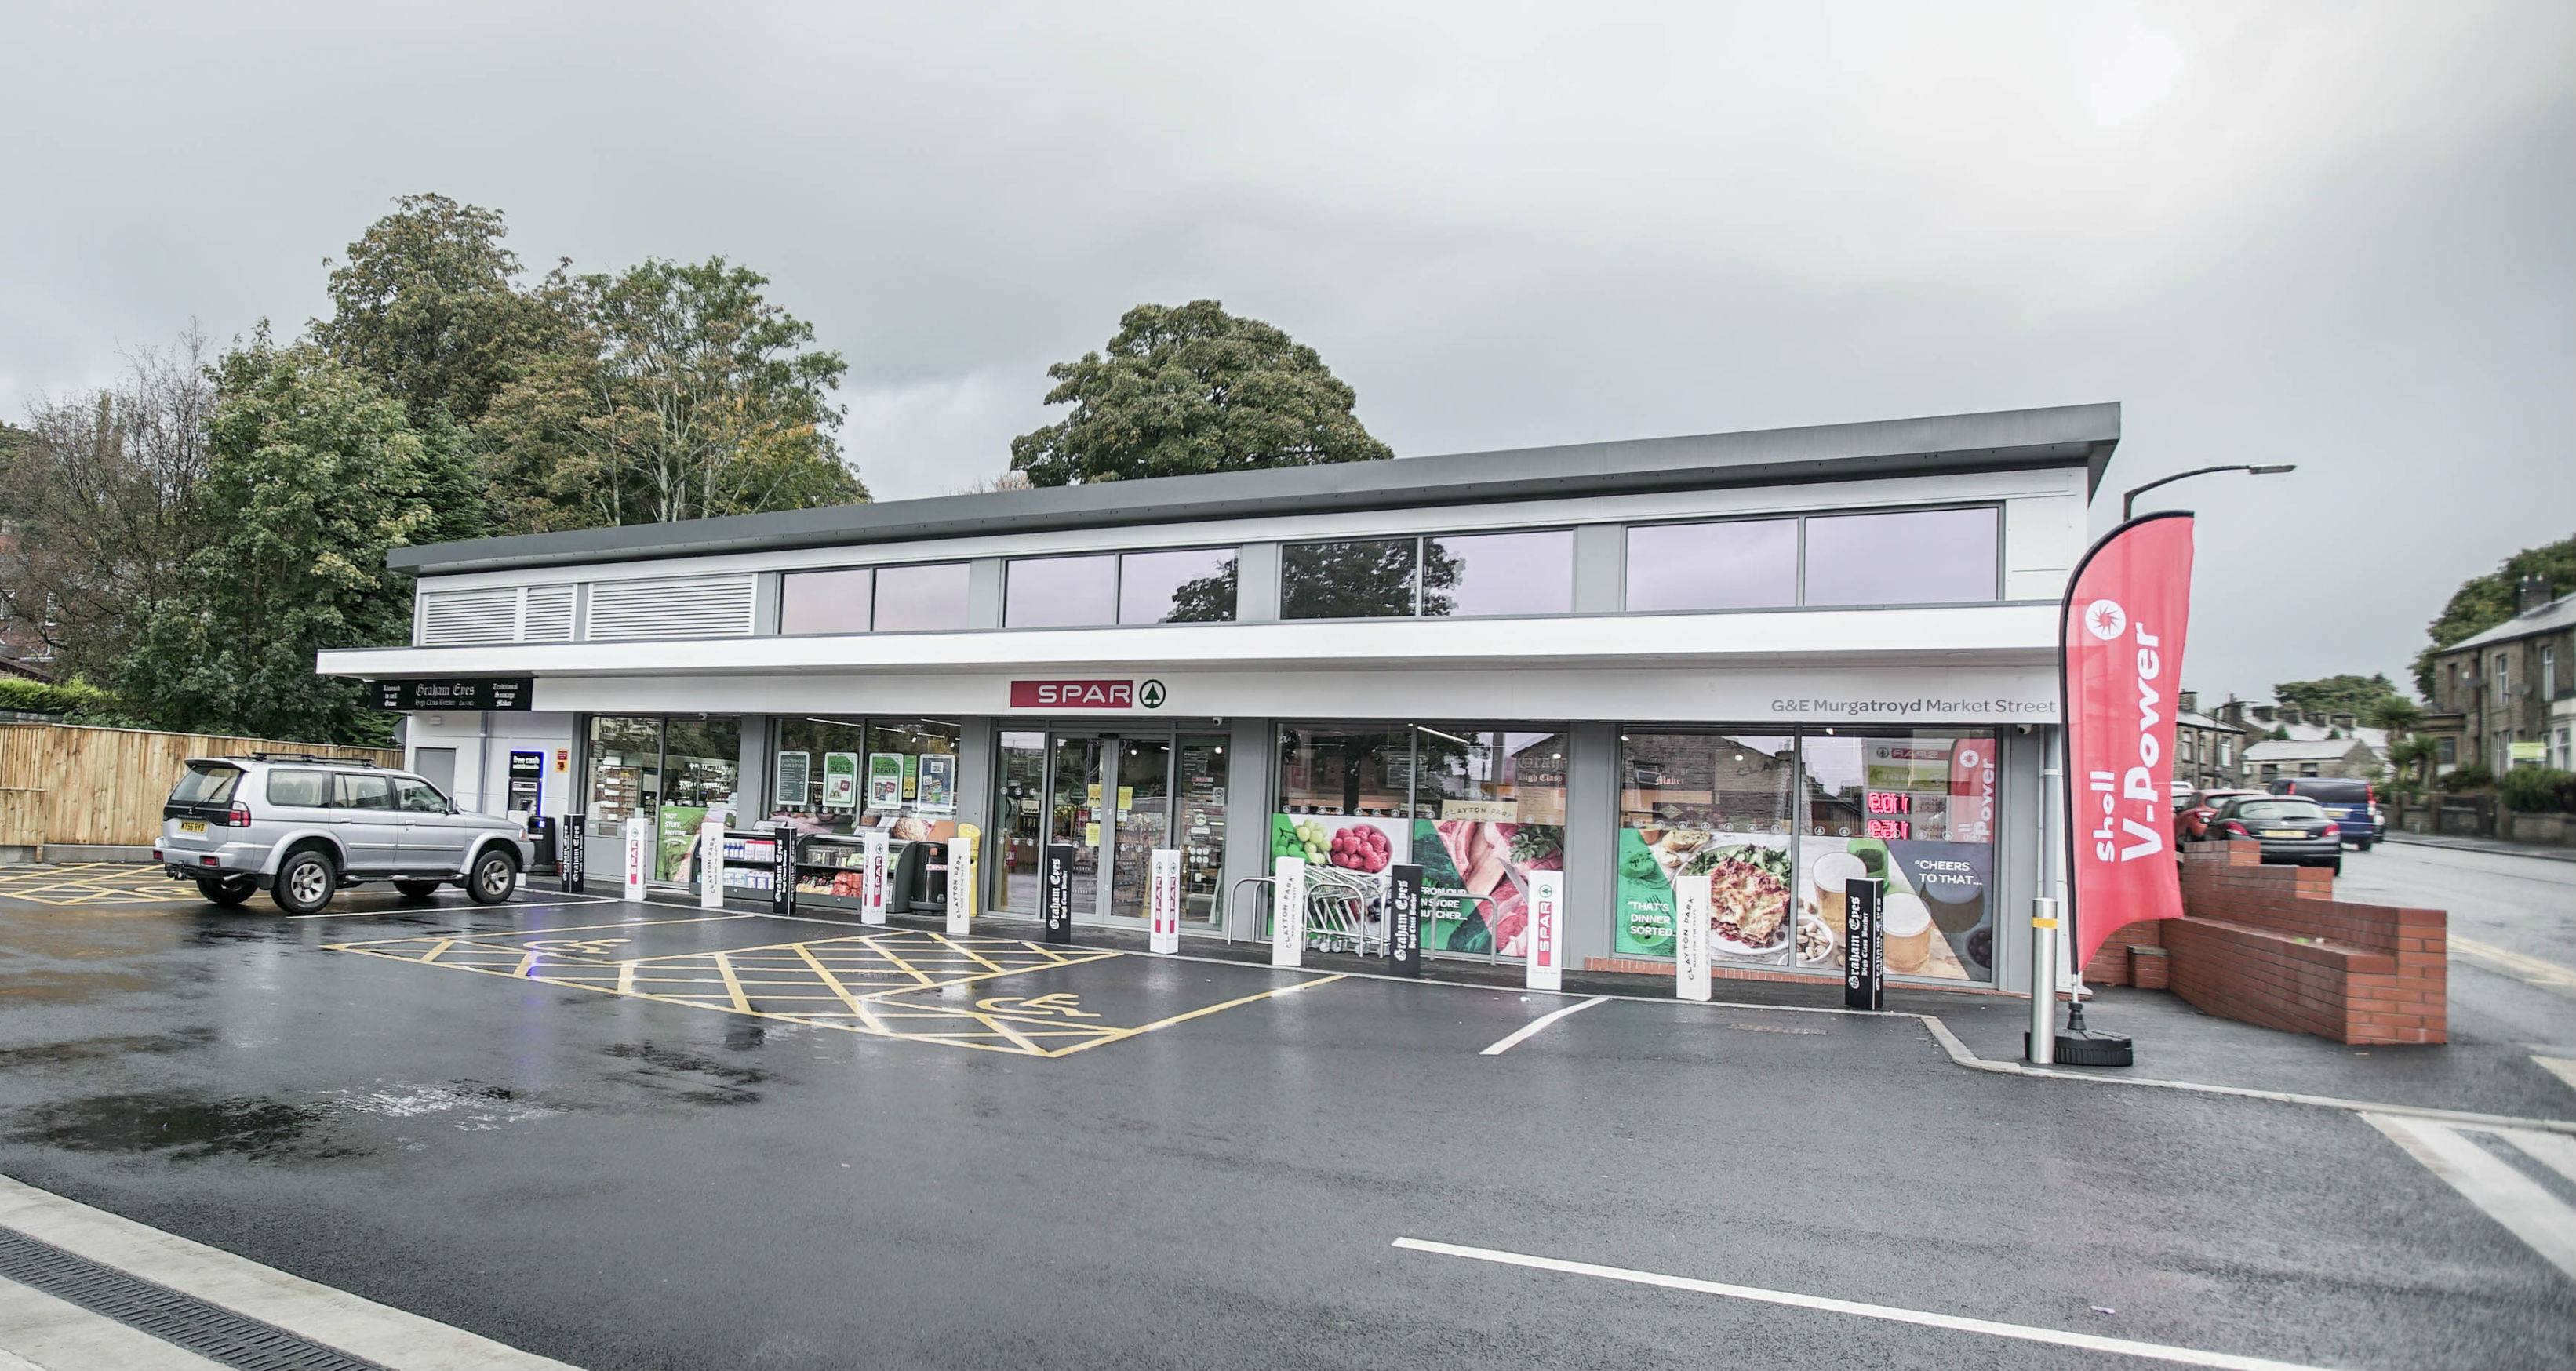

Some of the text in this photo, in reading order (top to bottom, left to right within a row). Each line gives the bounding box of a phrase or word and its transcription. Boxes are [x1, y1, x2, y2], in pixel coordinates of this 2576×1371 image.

[416, 683, 475, 698] Graham Eyes
[1038, 685, 1131, 704] SPAR
[1771, 699, 2057, 715] G&E Murgatroyd Market Street
[2121, 622, 2163, 862] V-Power
[1539, 773, 1563, 782] Class
[1444, 807, 1486, 816] CLAYTON
[875, 856, 883, 895] SPAR
[954, 855, 962, 876] PARK
[1914, 860, 1970, 871] "CHEERS
[707, 859, 715, 893] CLAYTON
[1919, 873, 1983, 886] TO THAT...
[1050, 858, 1062, 930] Graham Eyes
[1428, 899, 1460, 909] STORE
[1282, 877, 1295, 949] CLAYTON PARK
[1627, 900, 1670, 912] "THAT'S
[1394, 880, 1410, 961] Graham Eyes
[1539, 902, 1551, 952] SPAR
[1630, 913, 1671, 924] DINNER
[1683, 898, 1694, 980] CLAYTON PARK
[1848, 896, 1862, 989] Graham Eyes
